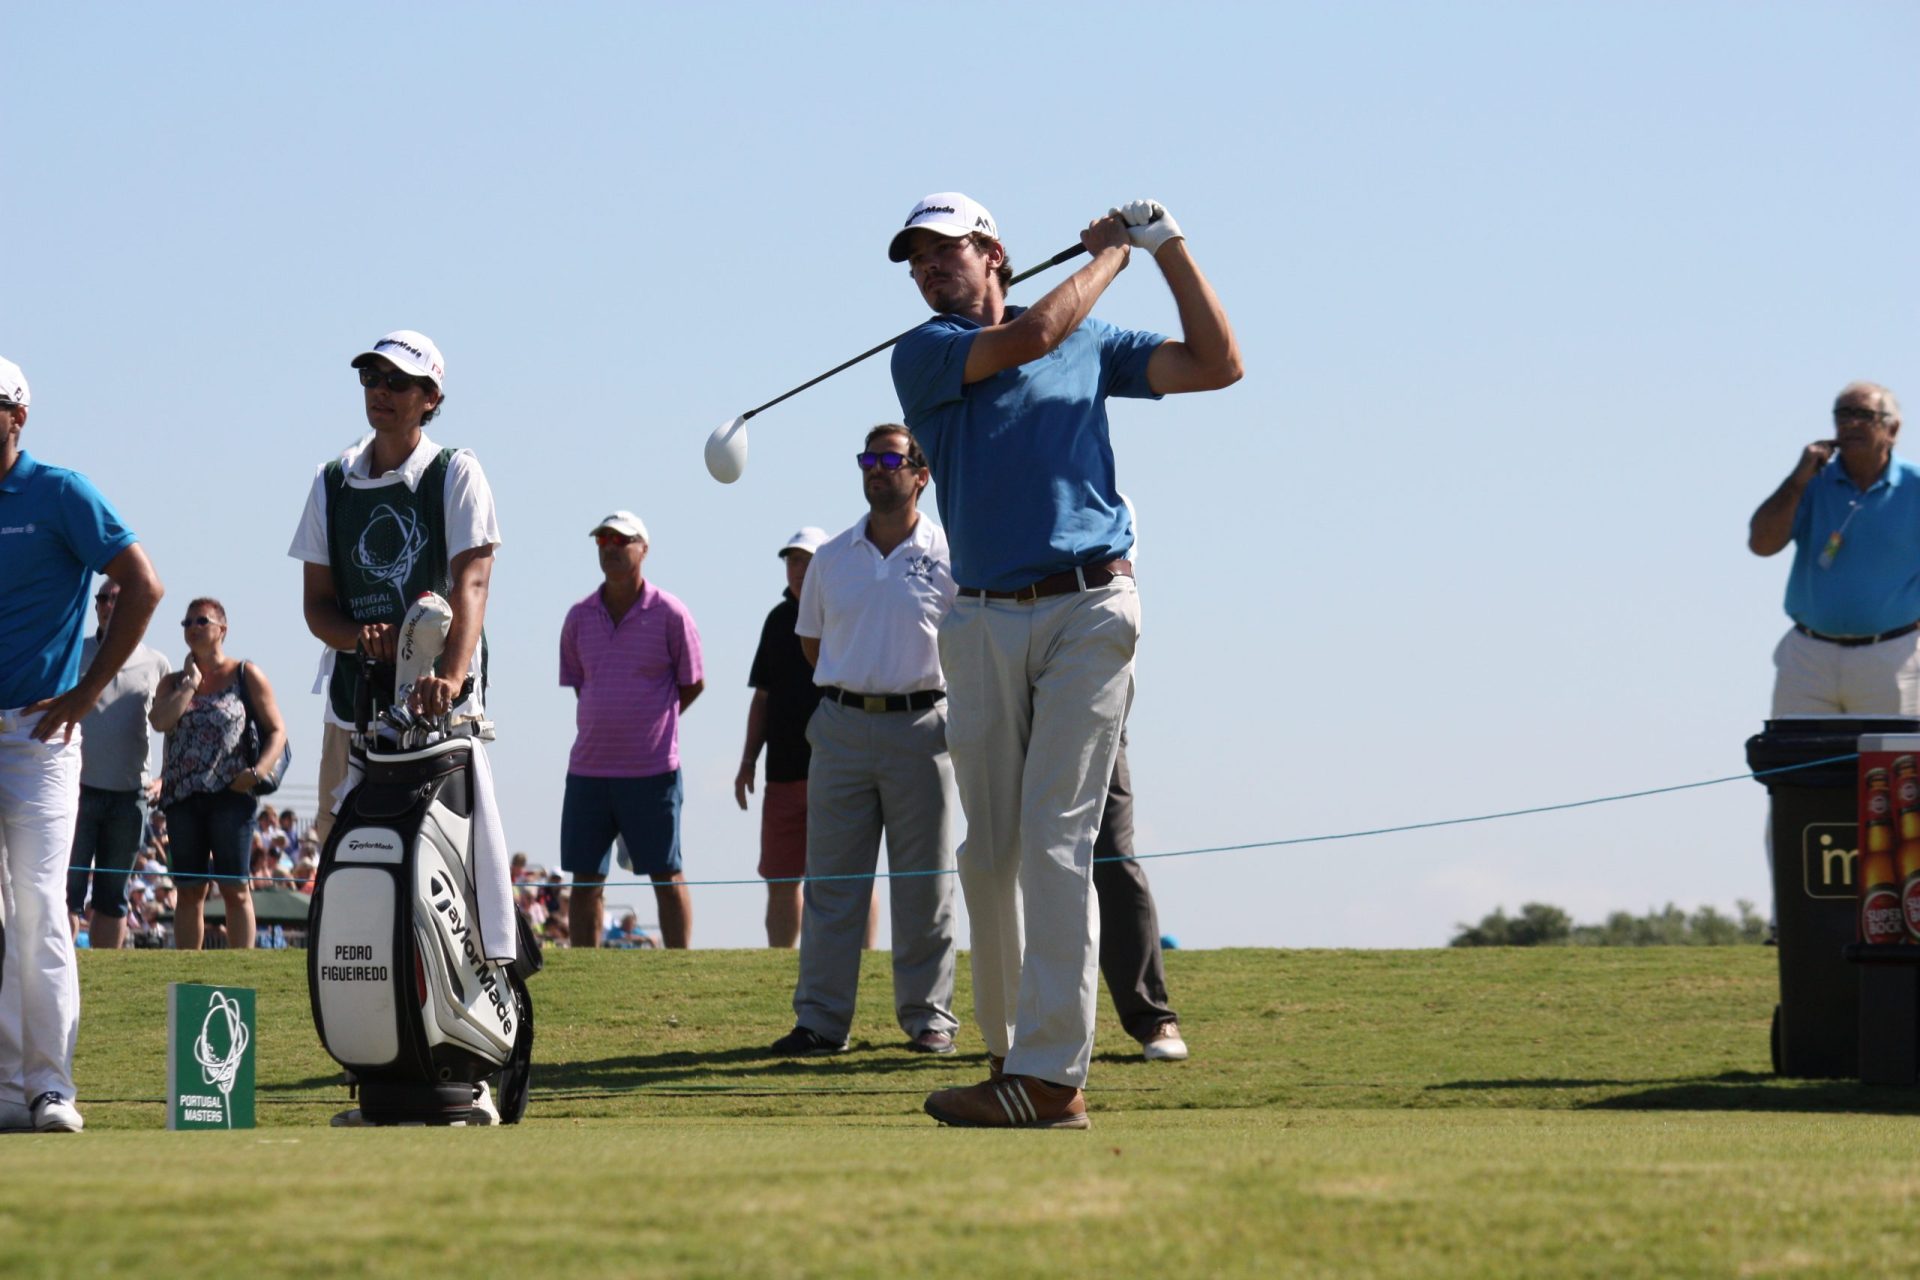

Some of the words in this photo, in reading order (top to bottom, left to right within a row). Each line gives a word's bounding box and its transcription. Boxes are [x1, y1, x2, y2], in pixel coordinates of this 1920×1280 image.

[349, 840, 394, 850] TaylorMade
[335, 945, 372, 961] PEDRO
[430, 869, 513, 1036] TaylorMade
[321, 965, 388, 982] FIGUEIREDO
[180, 1095, 222, 1108] PORTUGAL
[184, 1109, 223, 1122] MASTERS
